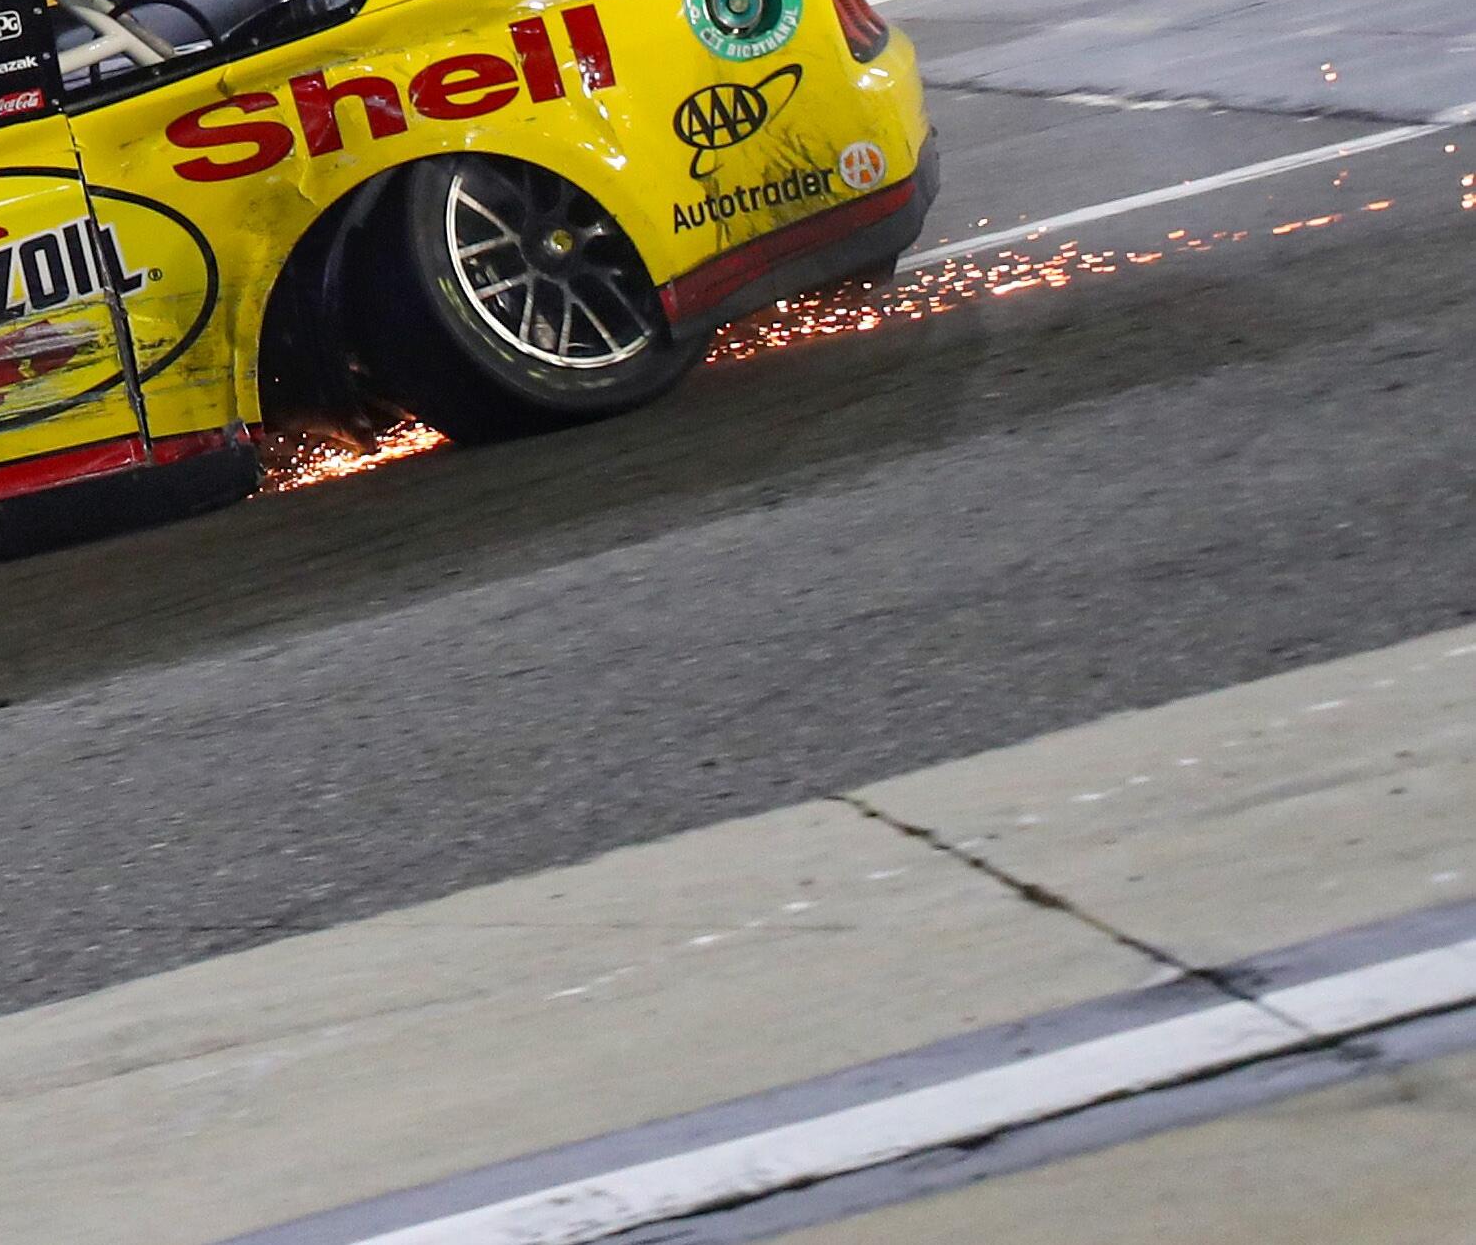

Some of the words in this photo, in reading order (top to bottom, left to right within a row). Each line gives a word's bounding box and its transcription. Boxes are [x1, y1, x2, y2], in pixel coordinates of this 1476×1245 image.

[166, 5, 616, 183] Shell
[687, 85, 761, 147] AAA
[673, 167, 834, 235] Autotrader
